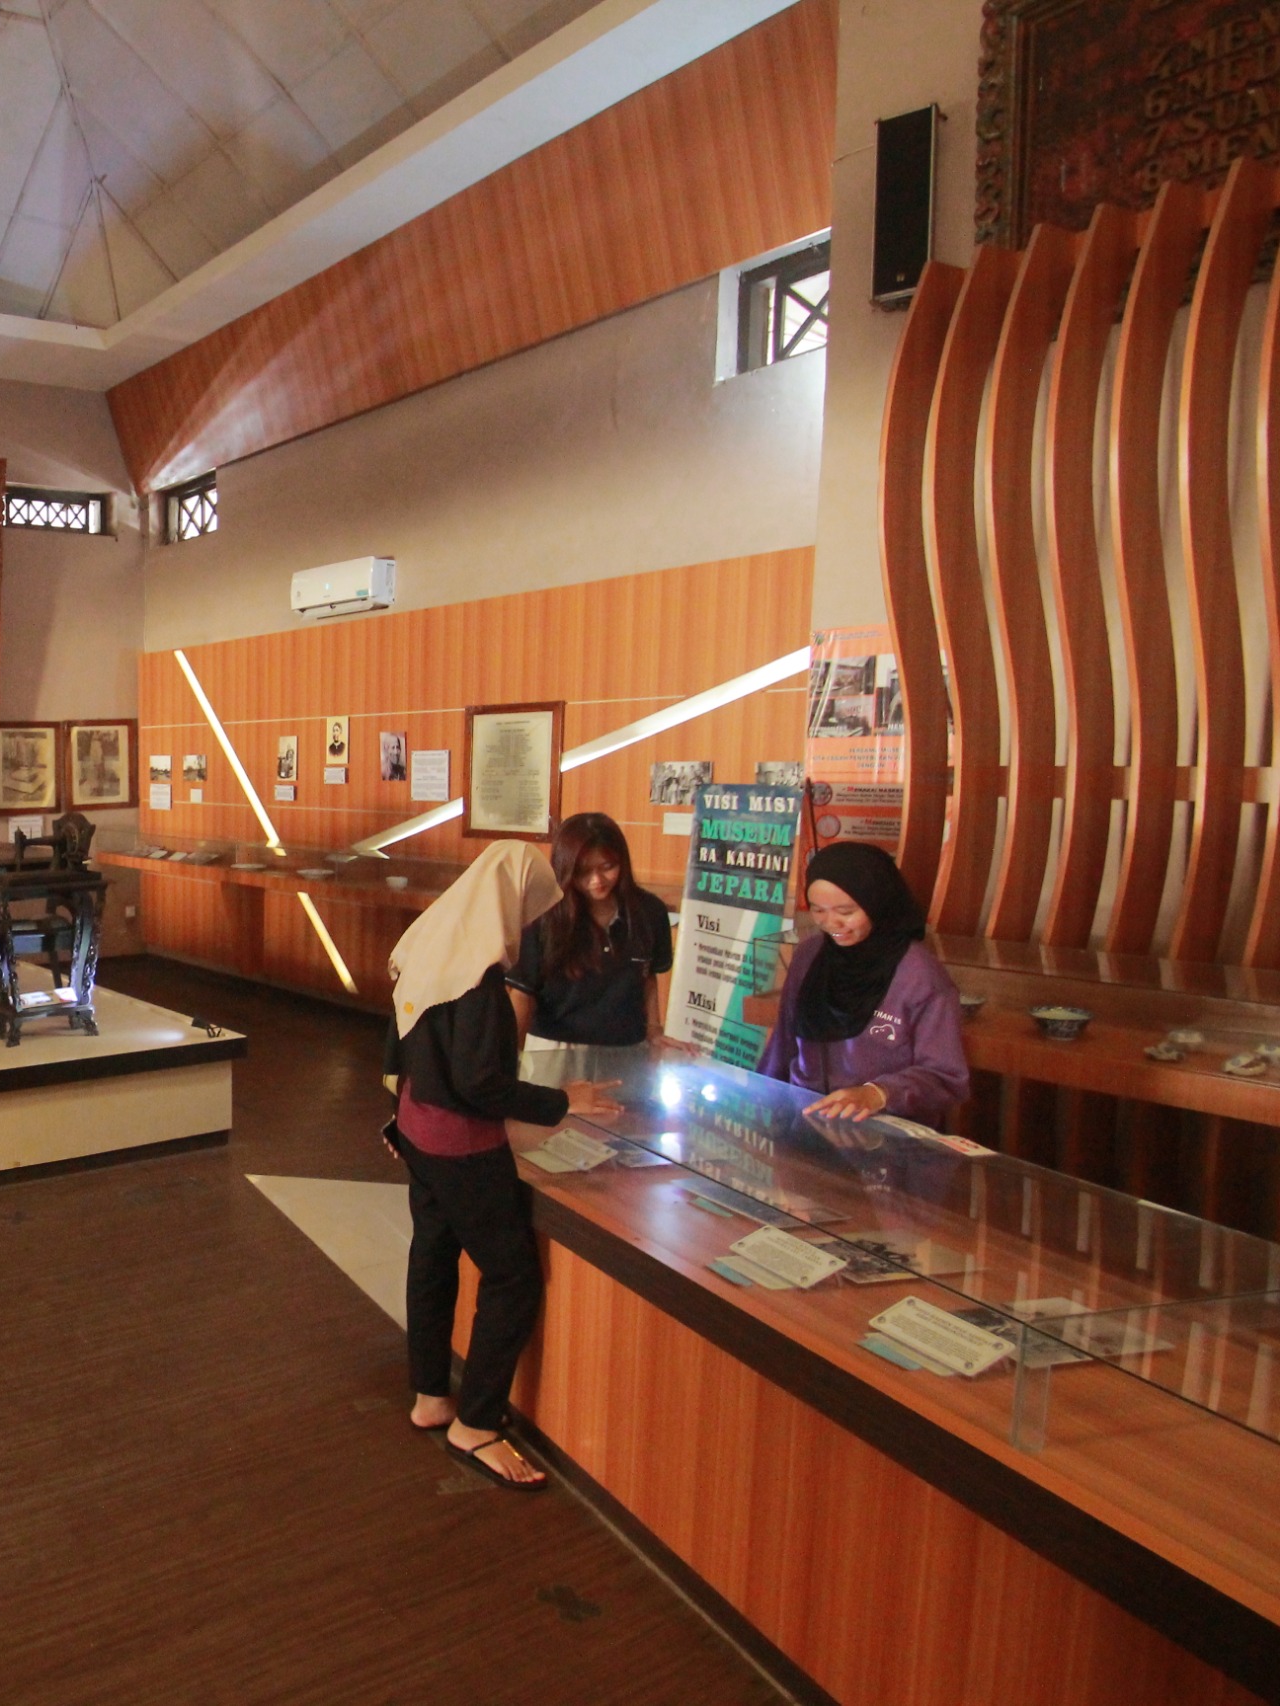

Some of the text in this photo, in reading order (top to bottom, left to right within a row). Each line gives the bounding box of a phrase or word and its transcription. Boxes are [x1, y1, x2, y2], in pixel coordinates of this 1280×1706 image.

[703, 793, 796, 814] VISI MISI
[701, 818, 791, 848] MUSEUM
[699, 846, 789, 873] RA KARTINI
[697, 871, 785, 905] JEPARA
[697, 914, 721, 933] Visi
[687, 989, 717, 1012] Misi
